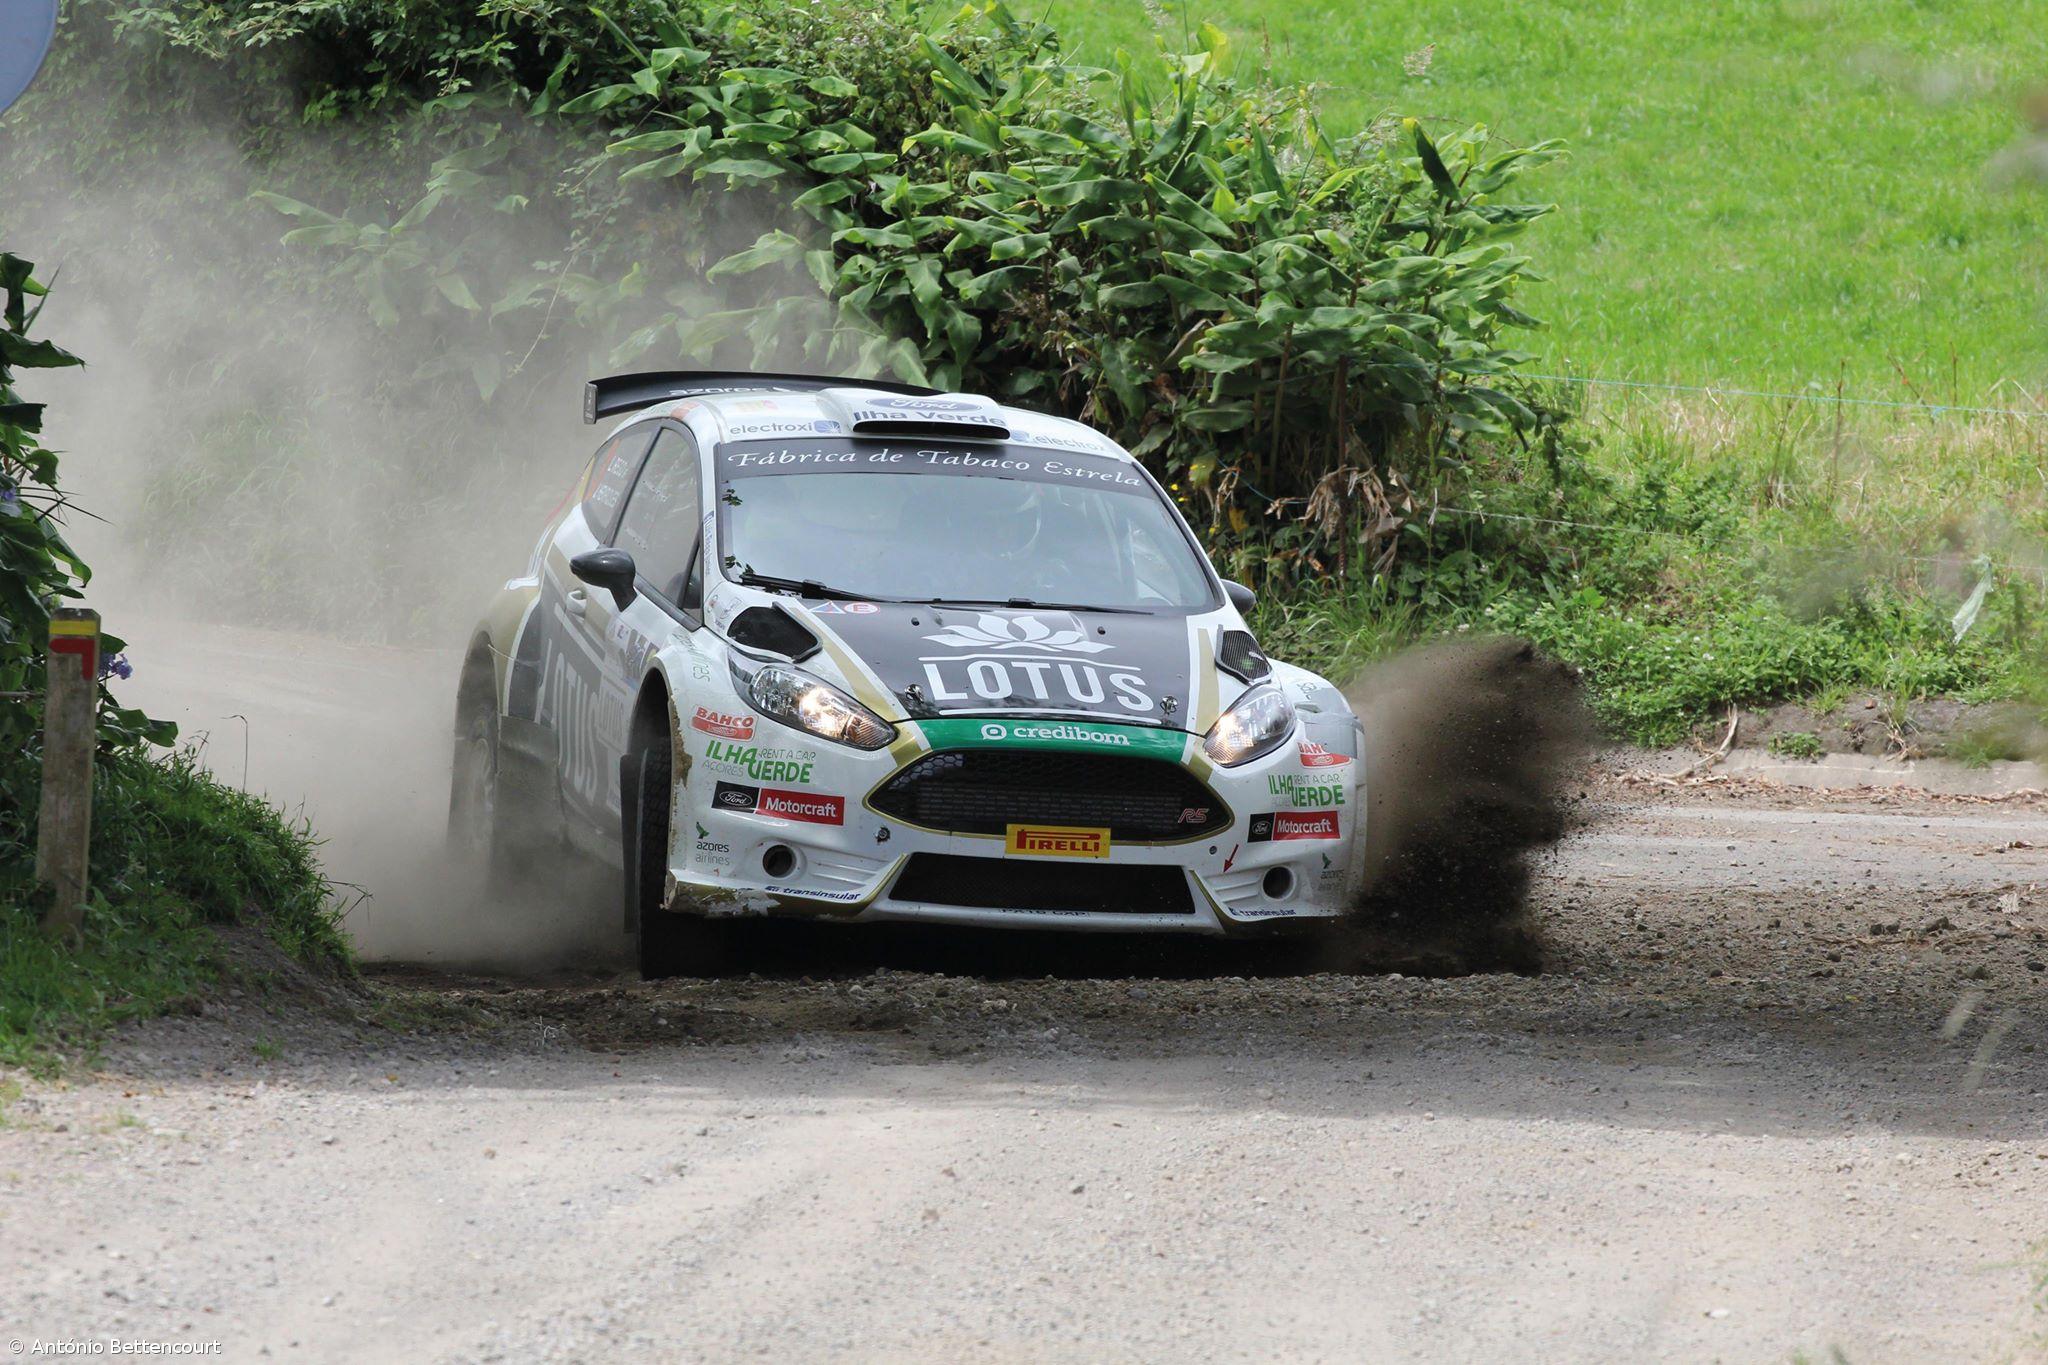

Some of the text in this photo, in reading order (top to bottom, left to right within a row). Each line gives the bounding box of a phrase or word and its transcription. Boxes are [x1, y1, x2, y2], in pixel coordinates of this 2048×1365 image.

[890, 399, 958, 410] Ford
[854, 410, 1006, 426] Ilha Verde
[728, 448, 1141, 486] Fábrica de Tabaco Estrela
[923, 660, 1154, 712] LOTUS
[696, 706, 754, 727] BAHCO
[1013, 725, 1130, 746] credibom
[706, 740, 757, 766] ILHA
[747, 760, 813, 783] VERDE
[1268, 774, 1294, 795] ILHA
[725, 792, 747, 805] Ford
[1292, 784, 1345, 807] VERDE
[765, 796, 836, 818] Motorcraft
[1178, 808, 1209, 824] RS
[1277, 819, 1332, 833] Motorcraft
[696, 841, 730, 853] azores
[1016, 830, 1101, 852] PIRELLI
[696, 852, 730, 866] airlines
[783, 887, 862, 901] transinsular
